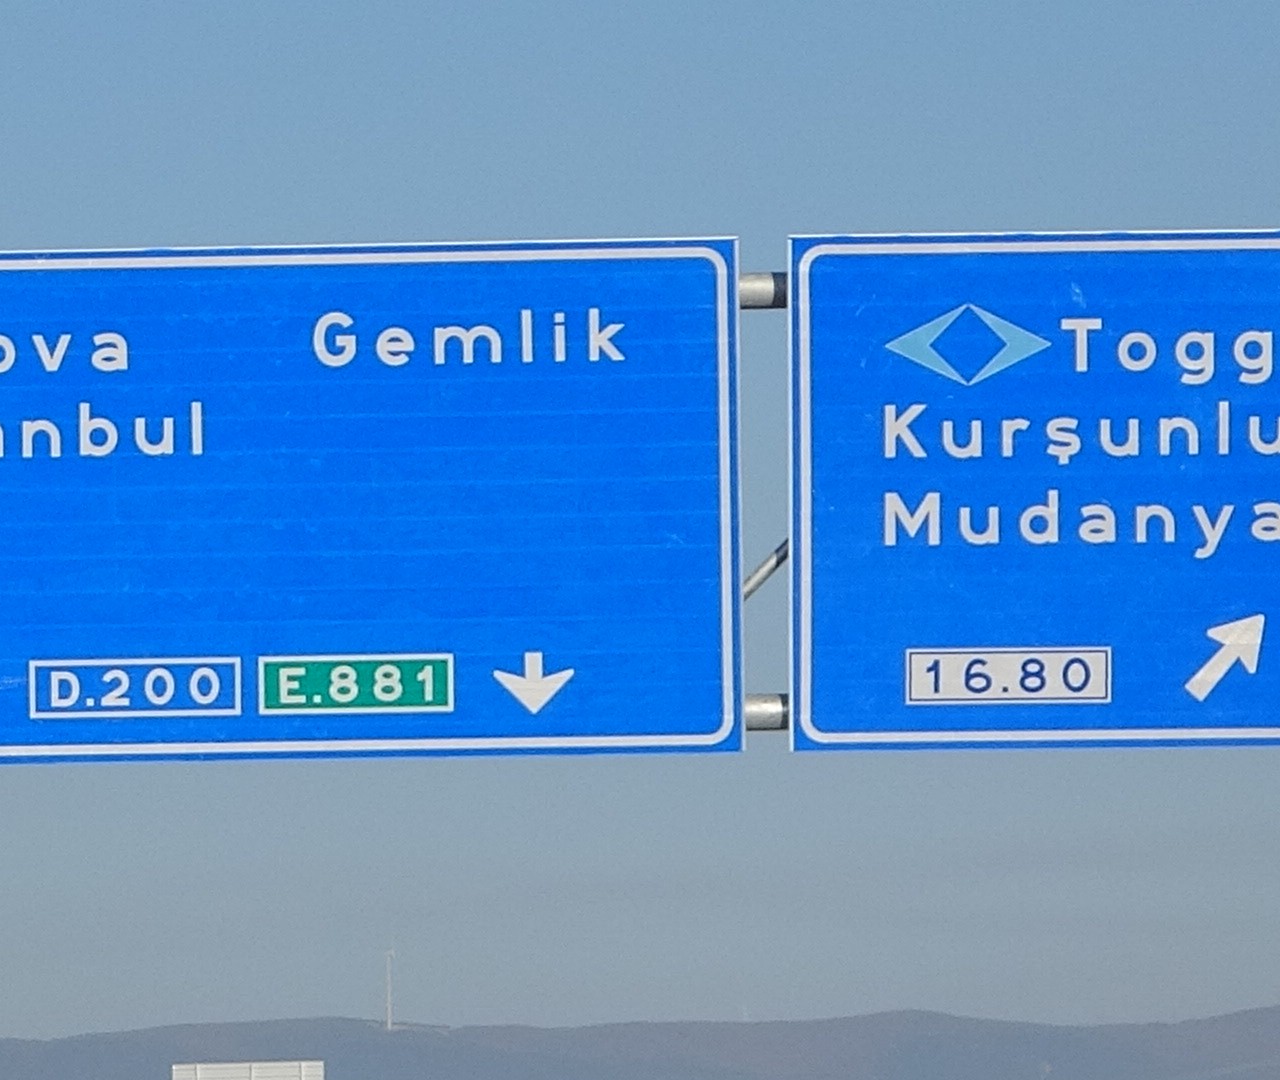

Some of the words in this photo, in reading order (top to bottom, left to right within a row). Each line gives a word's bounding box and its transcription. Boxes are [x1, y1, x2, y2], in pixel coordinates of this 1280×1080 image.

[313, 308, 626, 367] Gemlik
[1060, 317, 1274, 386] Togg
[50, 667, 220, 707] D.200
[278, 664, 435, 704] E.881
[925, 657, 1092, 695] 16.80
